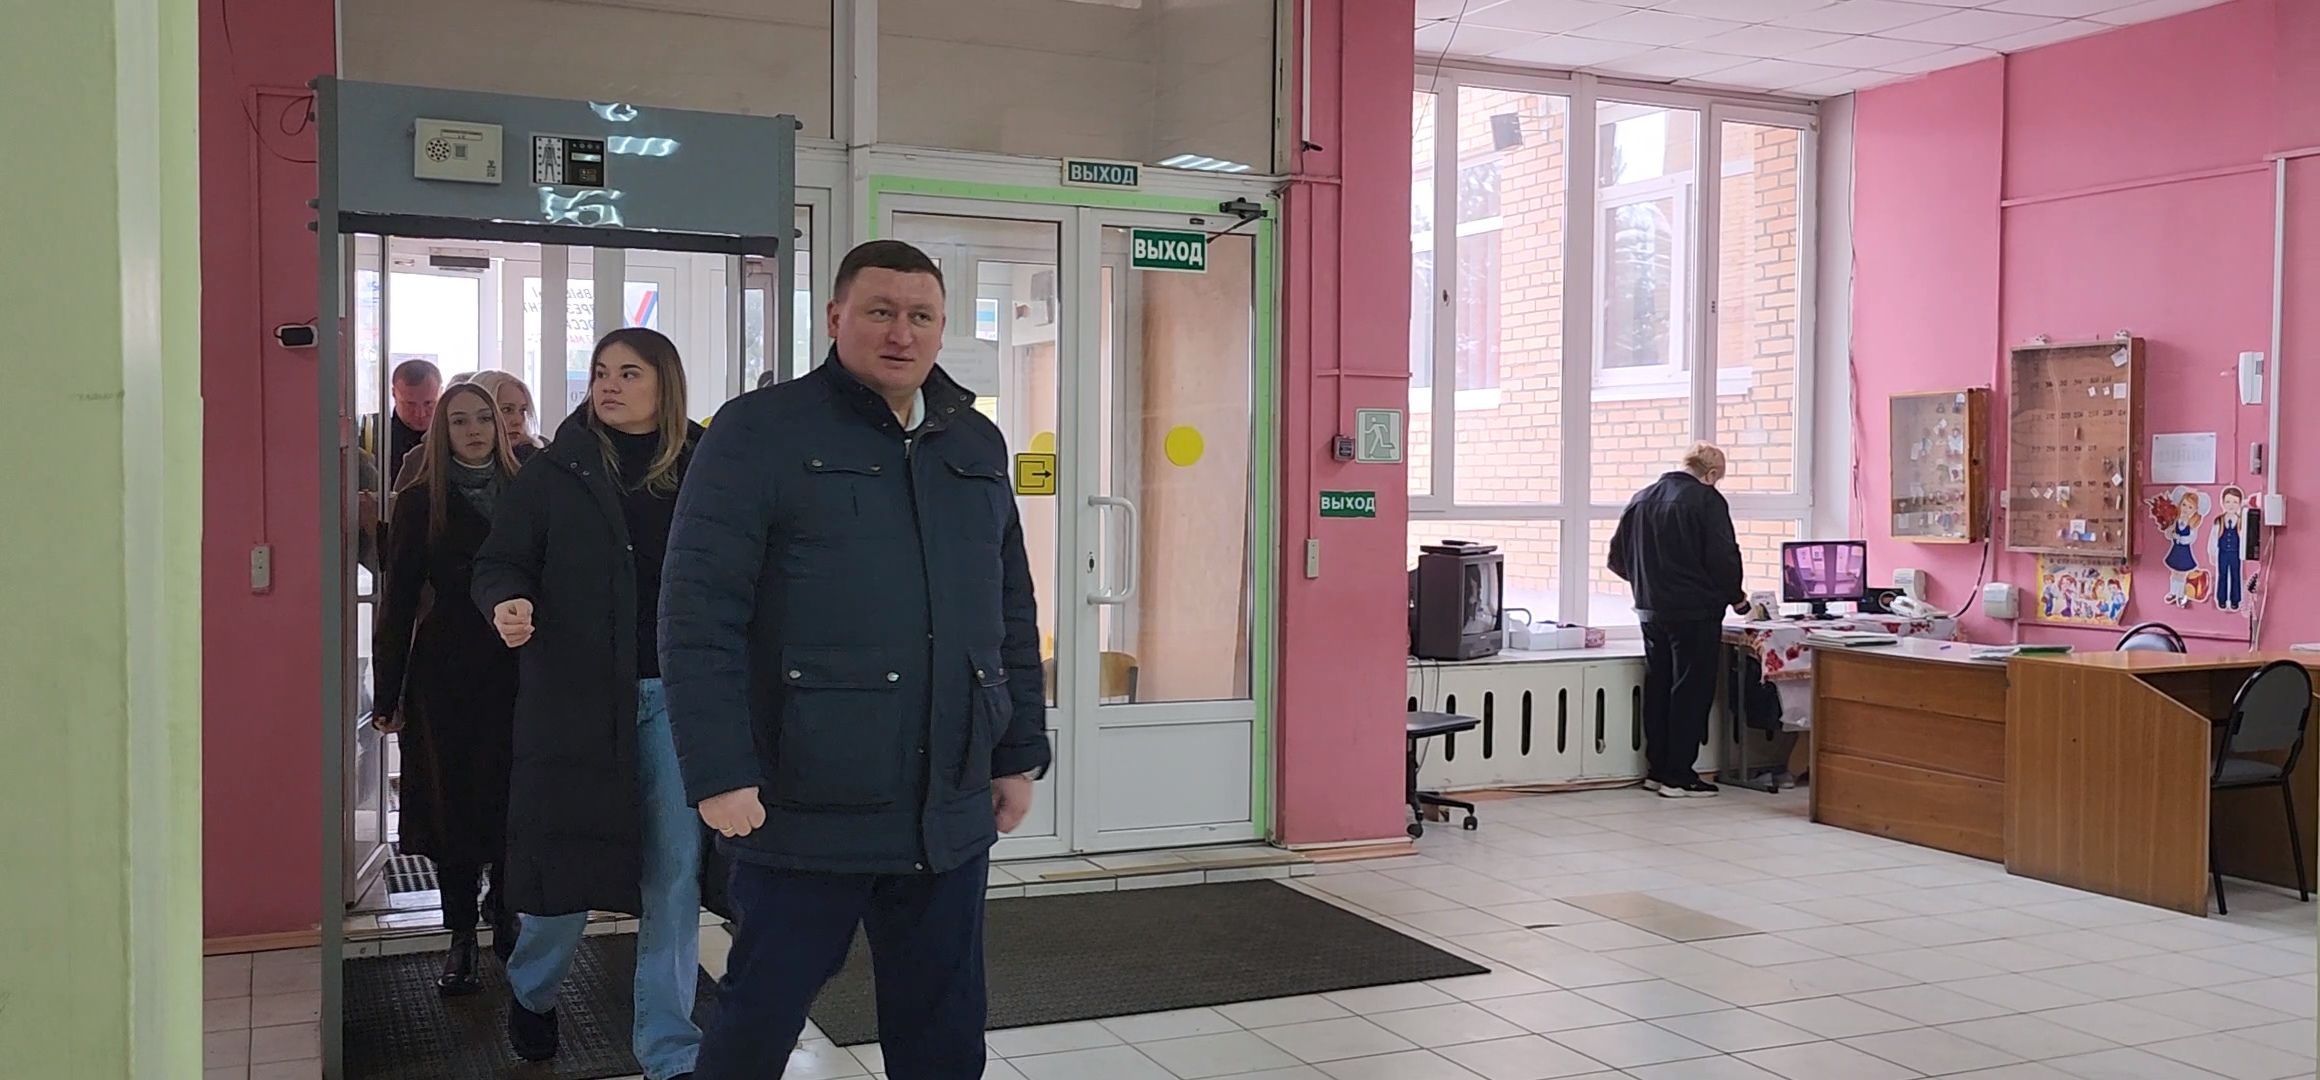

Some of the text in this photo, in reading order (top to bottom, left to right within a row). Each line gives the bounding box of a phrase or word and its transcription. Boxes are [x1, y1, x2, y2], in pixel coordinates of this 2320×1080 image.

[1071, 164, 1135, 185] ВЫХОД
[1134, 238, 1203, 266] ВЫХОД
[1321, 497, 1376, 512] ВЫХОД
